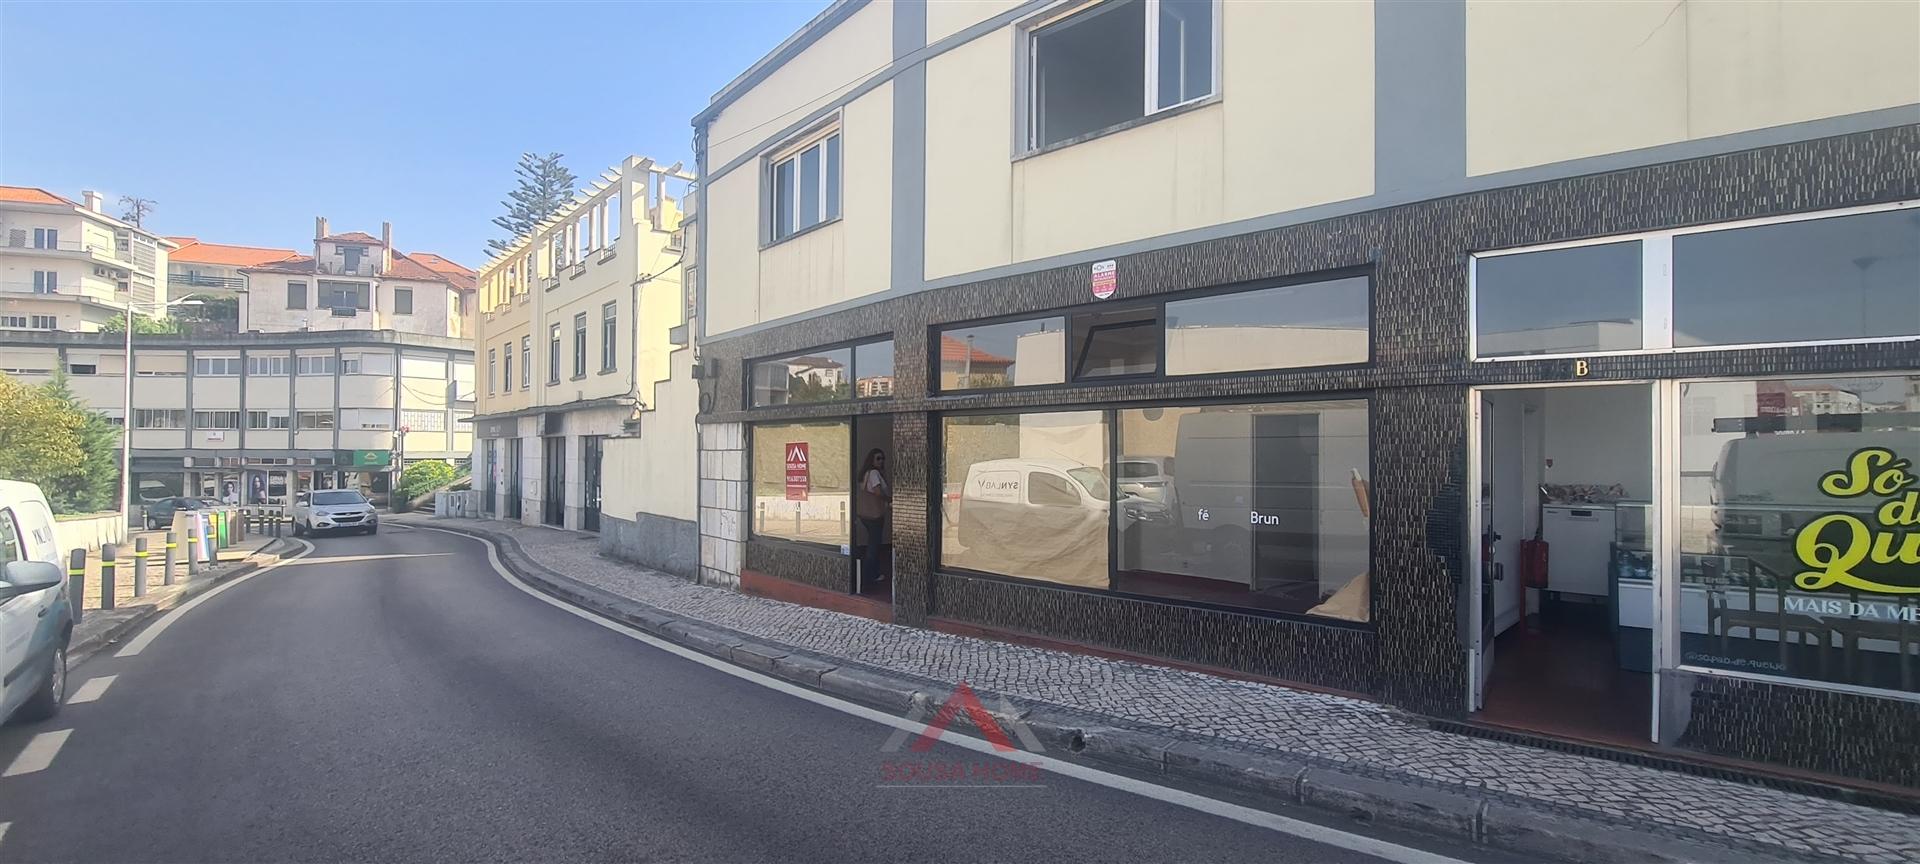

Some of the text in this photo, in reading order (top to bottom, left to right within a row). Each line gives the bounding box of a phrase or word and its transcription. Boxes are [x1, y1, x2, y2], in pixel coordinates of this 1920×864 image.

[1577, 360, 1588, 376] B
[1822, 450, 1913, 495] Só
[1250, 511, 1279, 525] Brun
[1879, 491, 1920, 525] d
[1784, 597, 1842, 615] MAIS
[1849, 602, 1880, 618] DA
